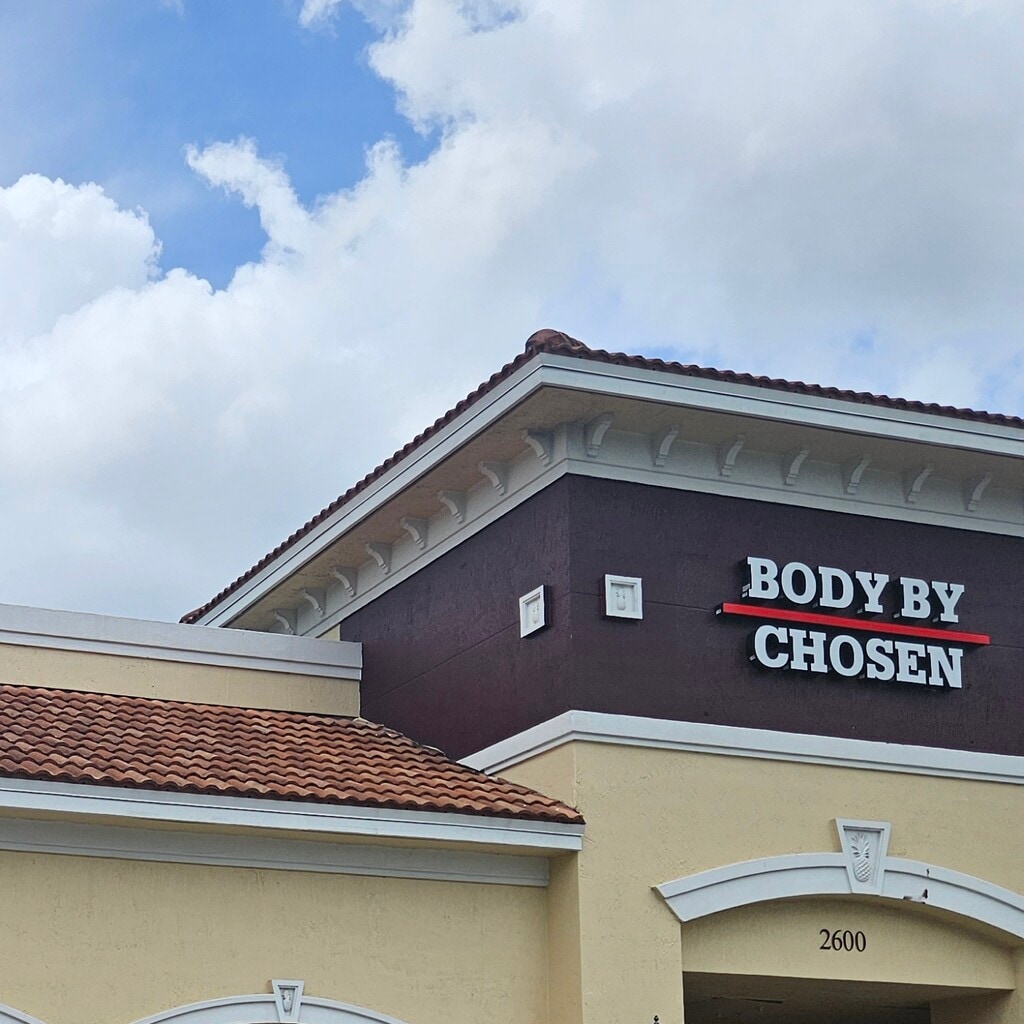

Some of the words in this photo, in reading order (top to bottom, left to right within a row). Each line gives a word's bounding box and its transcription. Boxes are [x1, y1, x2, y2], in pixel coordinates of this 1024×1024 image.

[747, 556, 889, 613] BODY
[900, 577, 964, 623] BY
[754, 625, 963, 688] CHOSEN
[819, 929, 866, 952] 2600
